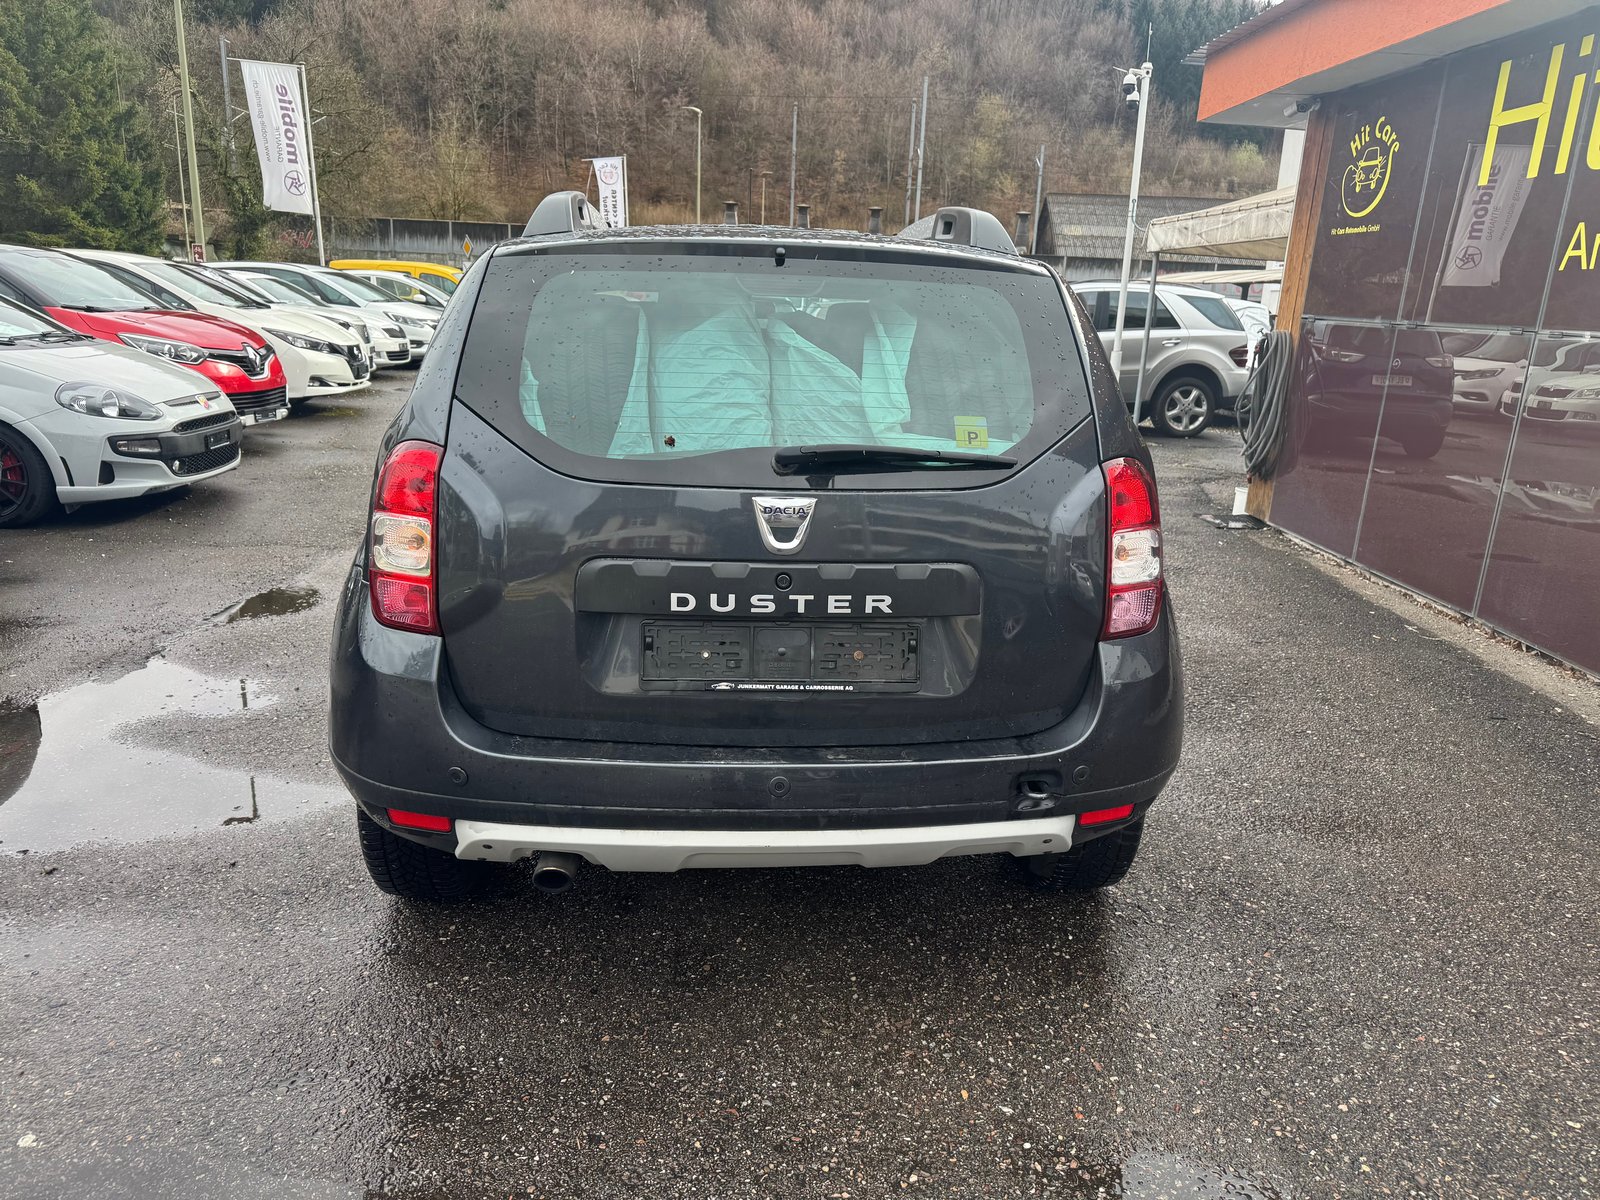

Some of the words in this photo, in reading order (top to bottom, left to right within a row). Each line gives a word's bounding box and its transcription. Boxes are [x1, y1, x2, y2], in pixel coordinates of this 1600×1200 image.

[1350, 124, 1371, 157] Hit
[1486, 205, 1500, 241] GARANTIE
[968, 431, 979, 445] P
[763, 506, 807, 516] DACIA
[670, 592, 893, 615] DUSTER
